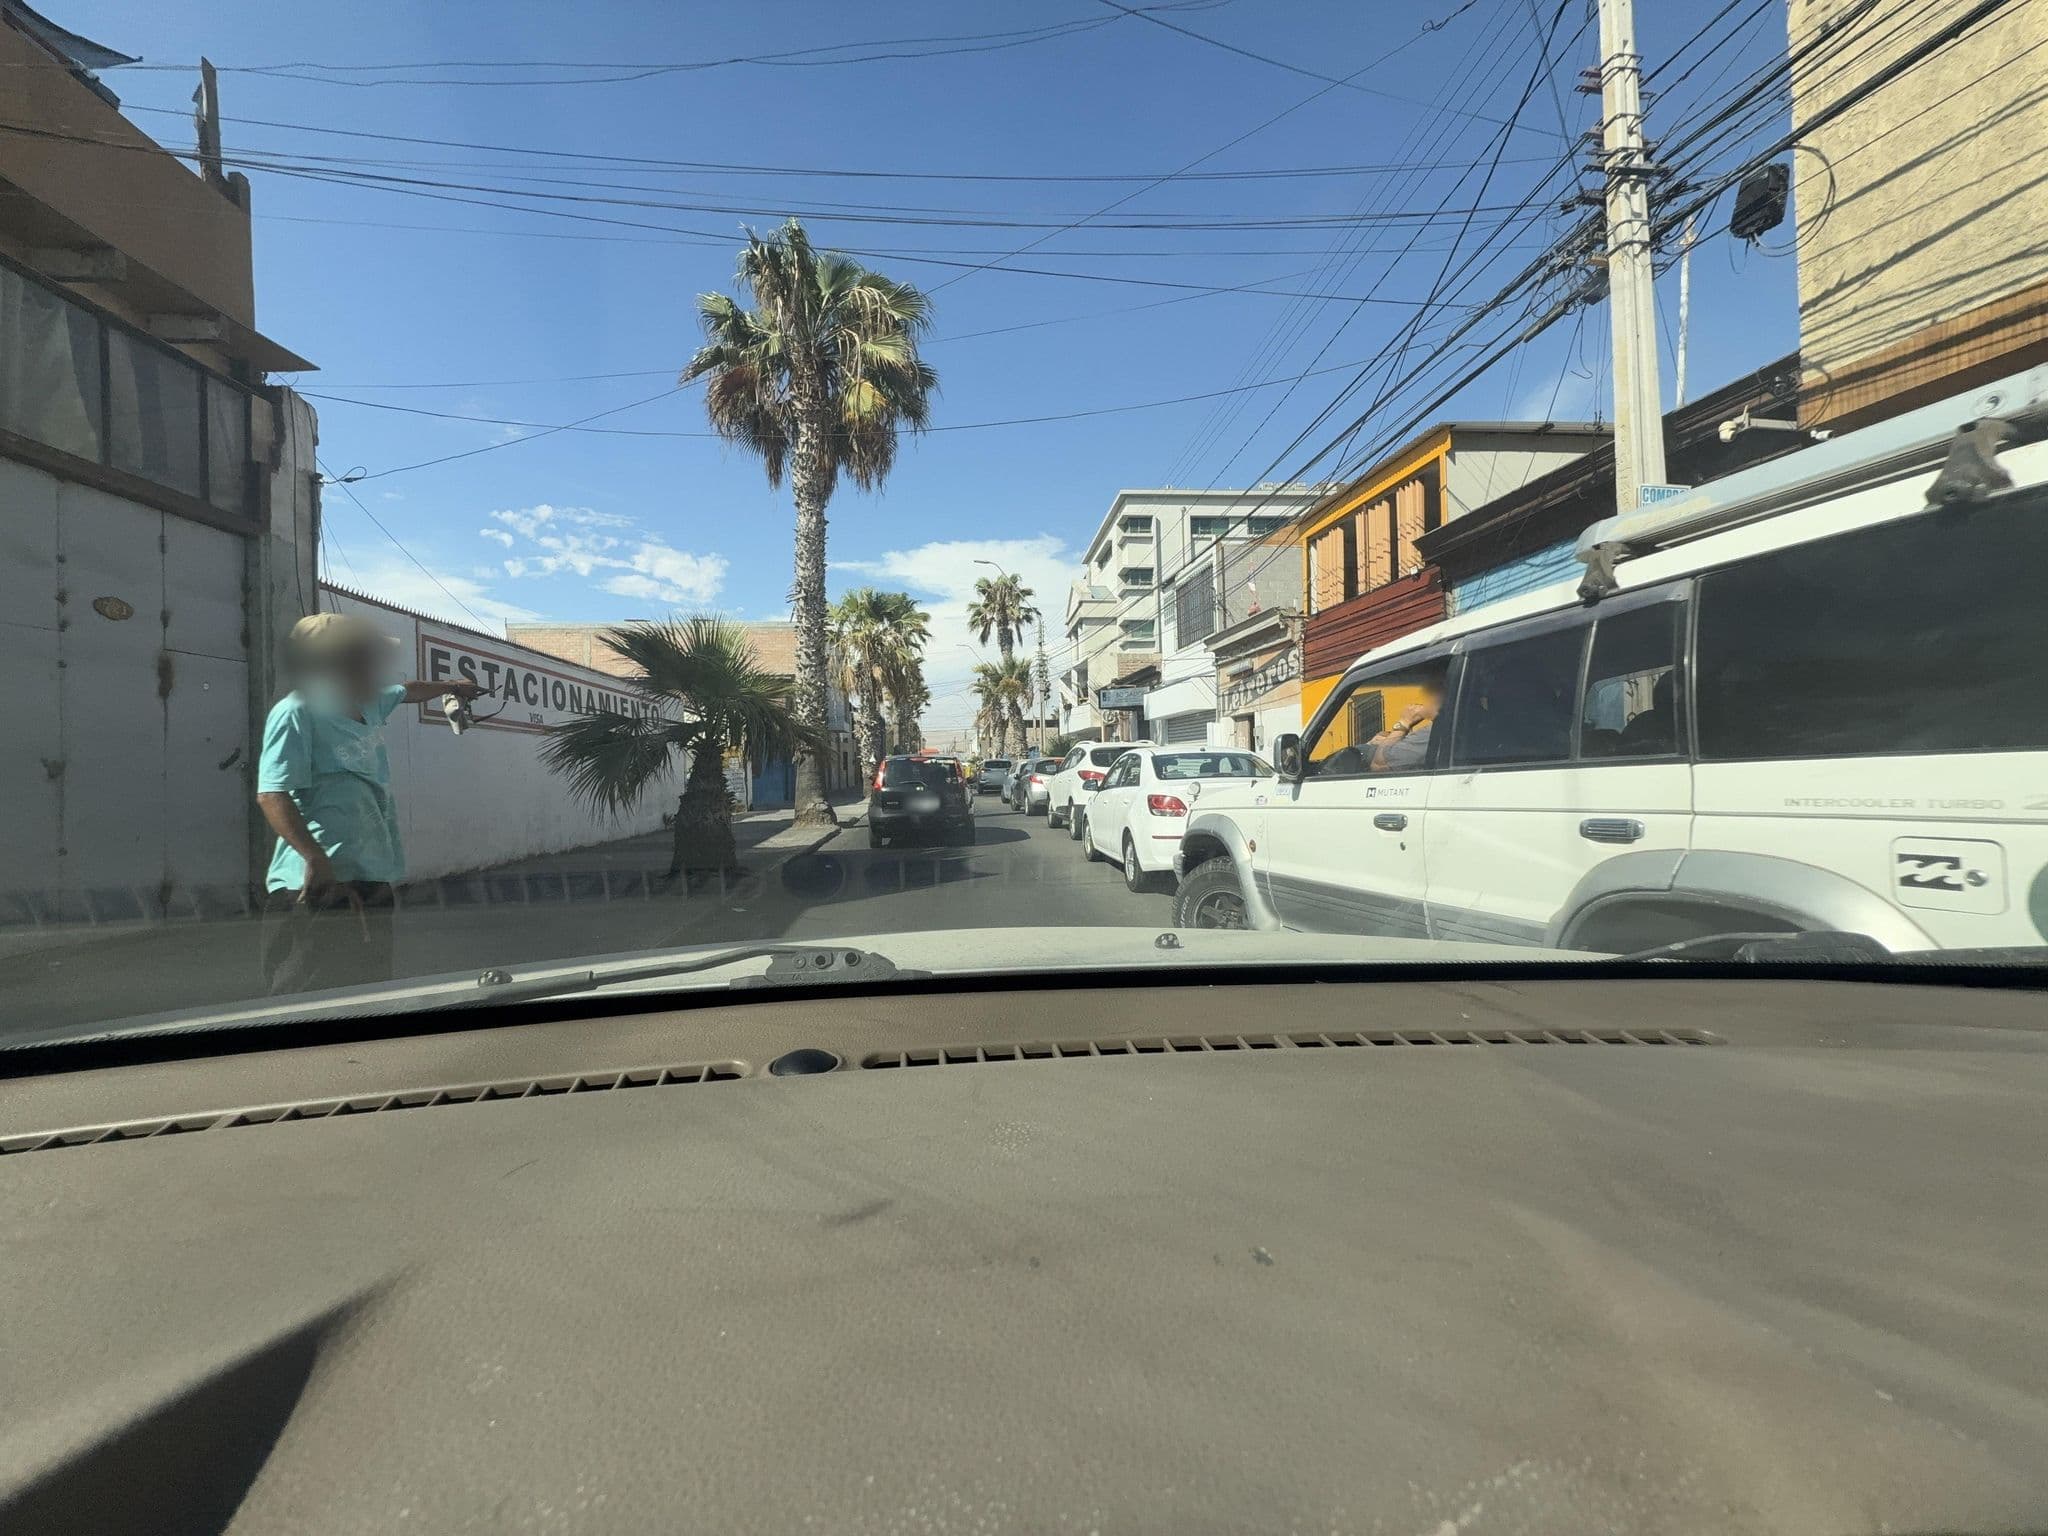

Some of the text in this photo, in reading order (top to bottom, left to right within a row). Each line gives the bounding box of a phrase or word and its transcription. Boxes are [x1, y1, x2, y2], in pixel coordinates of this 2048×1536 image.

[431, 647, 660, 727] ESTACIONAMIENTO
[1784, 798, 1915, 808] INTERCOOLER
[1928, 799, 2005, 809] TURBO
